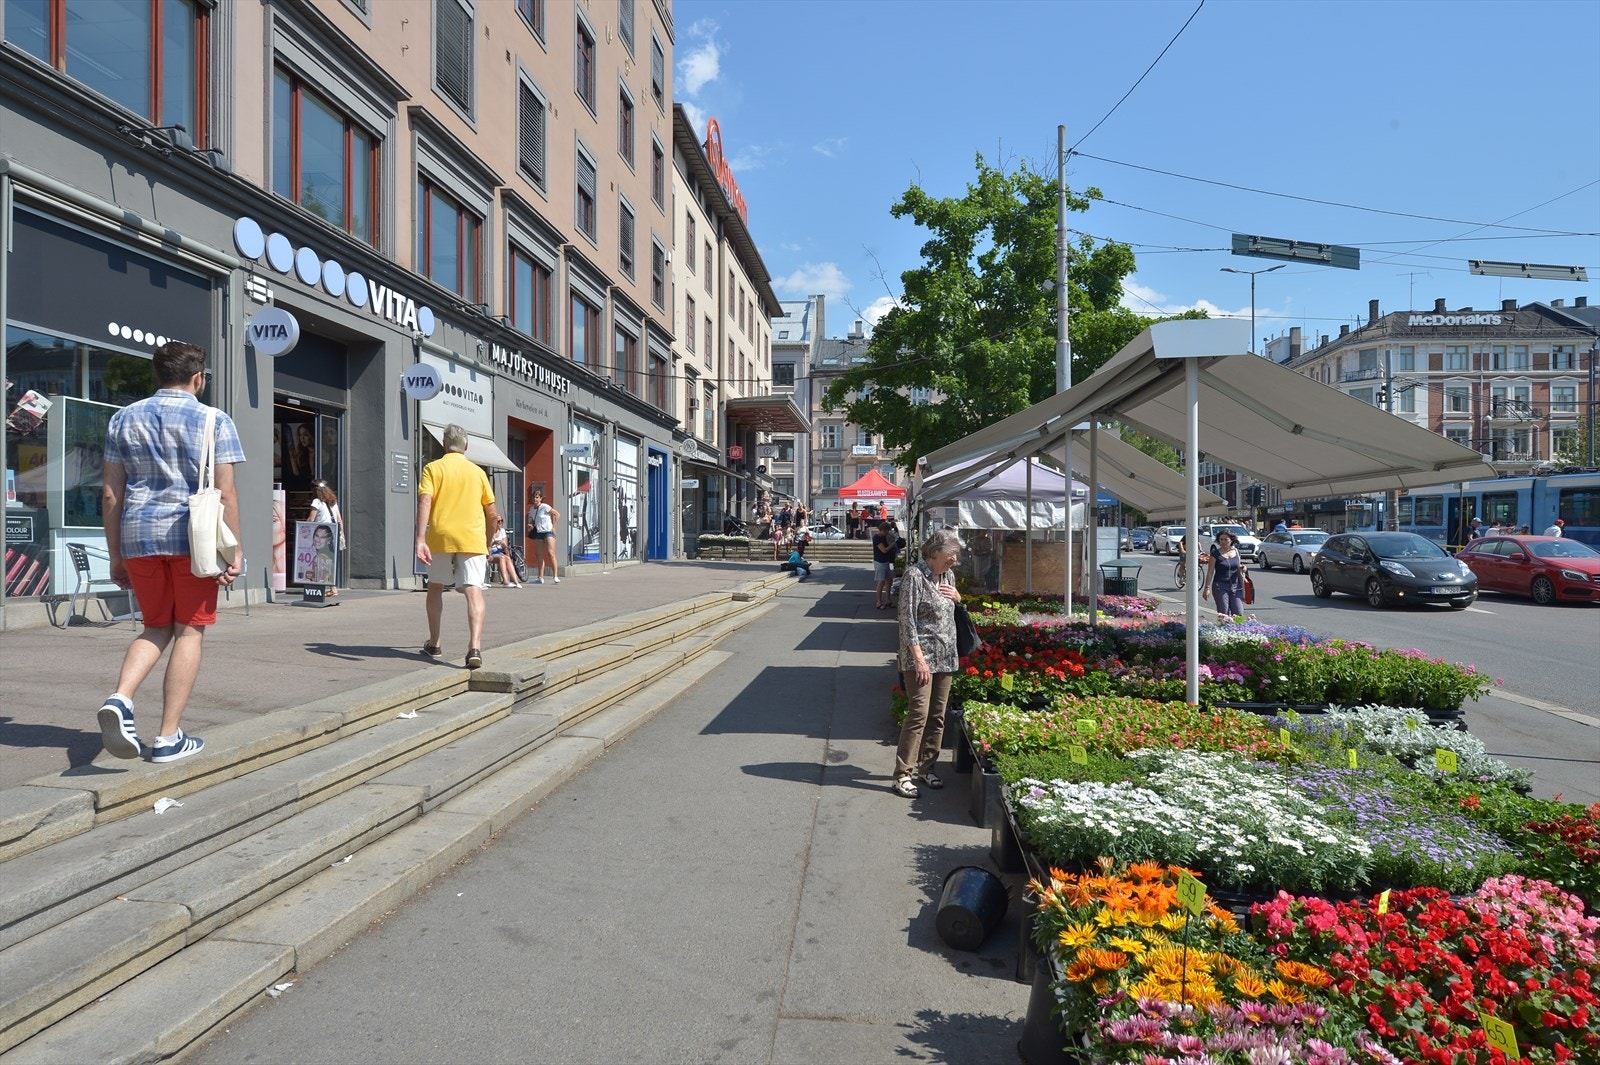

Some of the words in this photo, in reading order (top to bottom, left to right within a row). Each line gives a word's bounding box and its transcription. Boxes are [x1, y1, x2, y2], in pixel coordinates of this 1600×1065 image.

[368, 278, 419, 332] VITA
[1408, 314, 1502, 326] McDonald's
[253, 324, 289, 338] VITA
[492, 343, 571, 394] MAJORSTUHUSET
[407, 376, 435, 387] VITA
[462, 389, 479, 404] VITA
[305, 588, 322, 597] VITA
